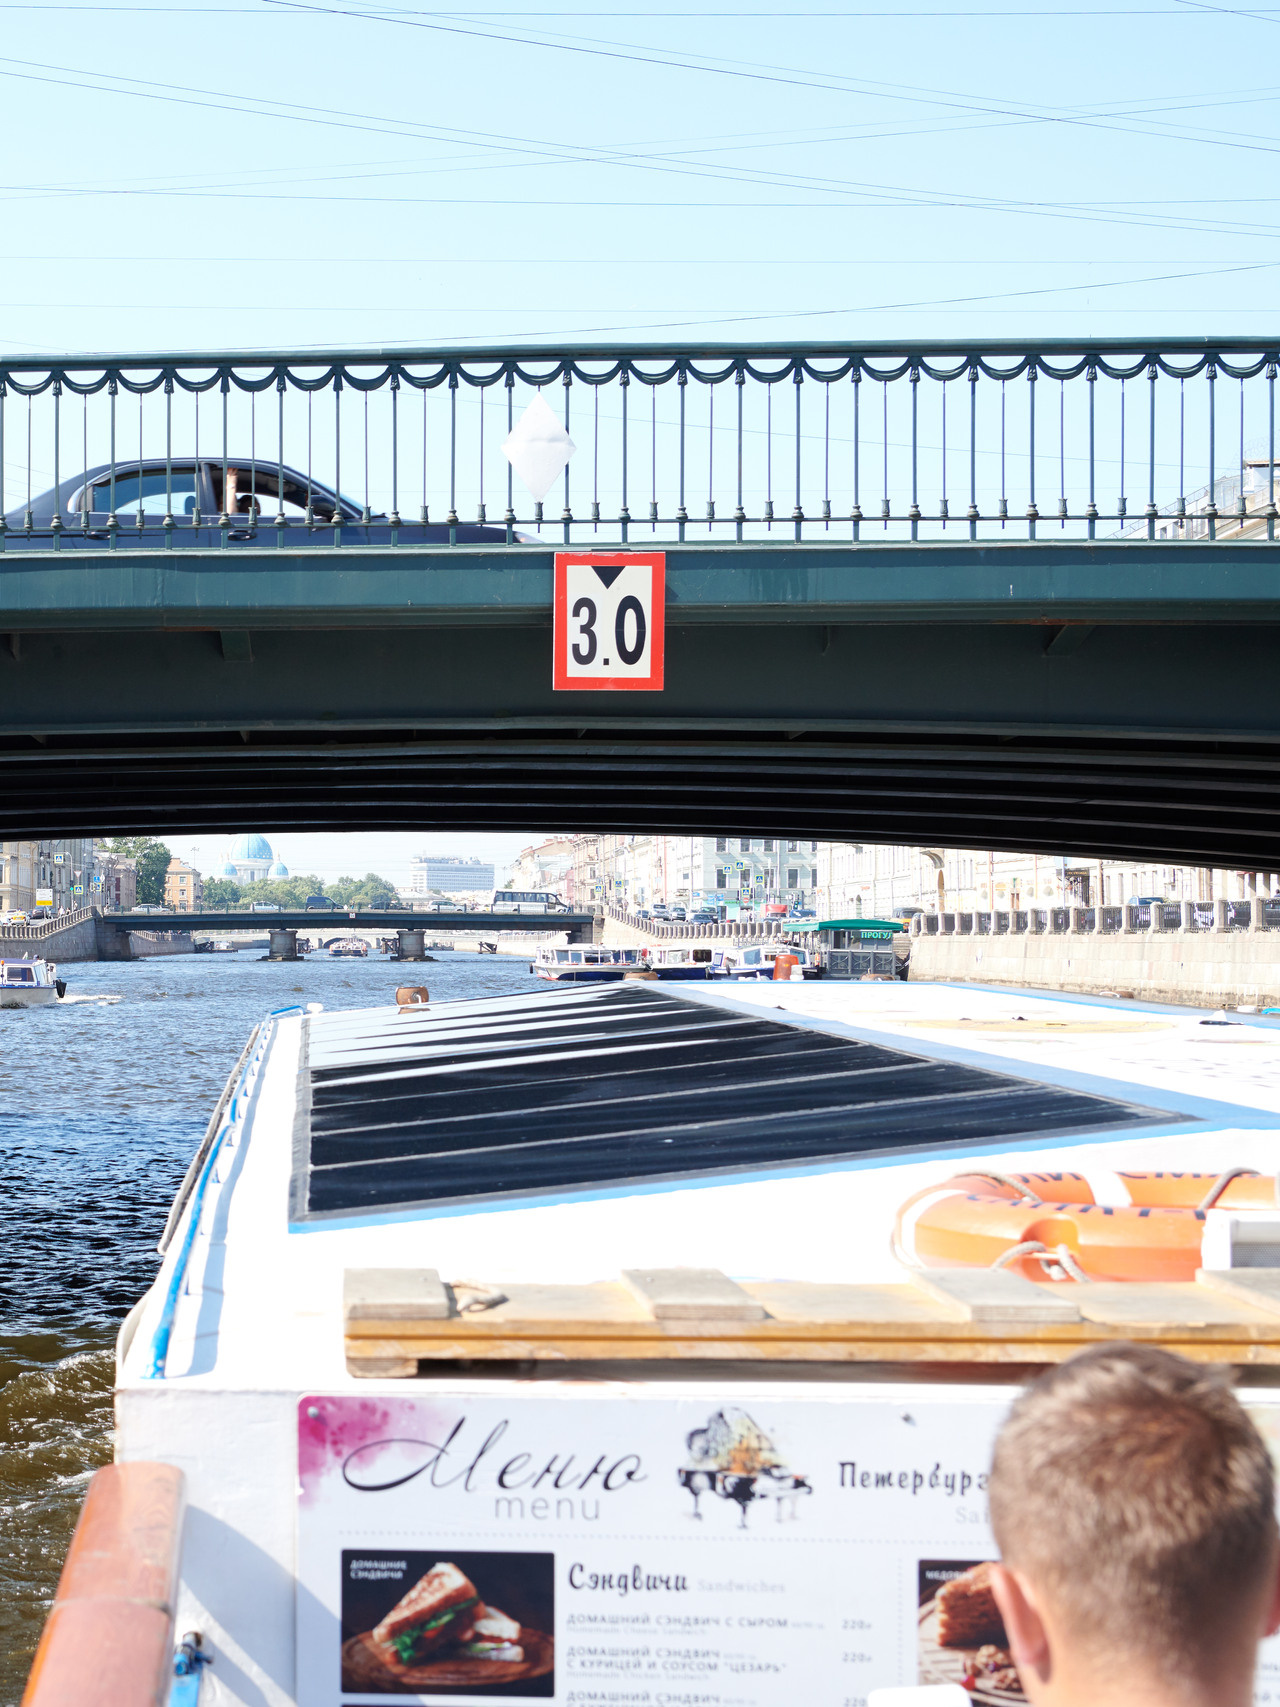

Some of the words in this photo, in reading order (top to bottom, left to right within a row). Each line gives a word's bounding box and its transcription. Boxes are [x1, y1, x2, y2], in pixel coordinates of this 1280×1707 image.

[572, 595, 646, 665] 3.0
[342, 1415, 649, 1493] Меню
[495, 1496, 600, 1521] menu
[568, 1562, 688, 1597] Сэндвичи
[567, 1612, 651, 1625] ДОМАШНИЙ
[655, 1614, 721, 1627] СЭНДВИЧ
[725, 1616, 733, 1627] С
[738, 1616, 789, 1628] СЫРОМ
[567, 1645, 651, 1657] ДОМАШНИЙ
[655, 1647, 721, 1660] СЭНДВИЧ
[567, 1658, 575, 1668] С
[580, 1657, 641, 1670] КУРИЦЕЙ
[647, 1660, 657, 1669] И
[661, 1660, 718, 1671] СОУСОМ
[567, 1690, 651, 1702] ДОМАШНИЙ
[655, 1692, 721, 1704] СЭНДВИЧ
